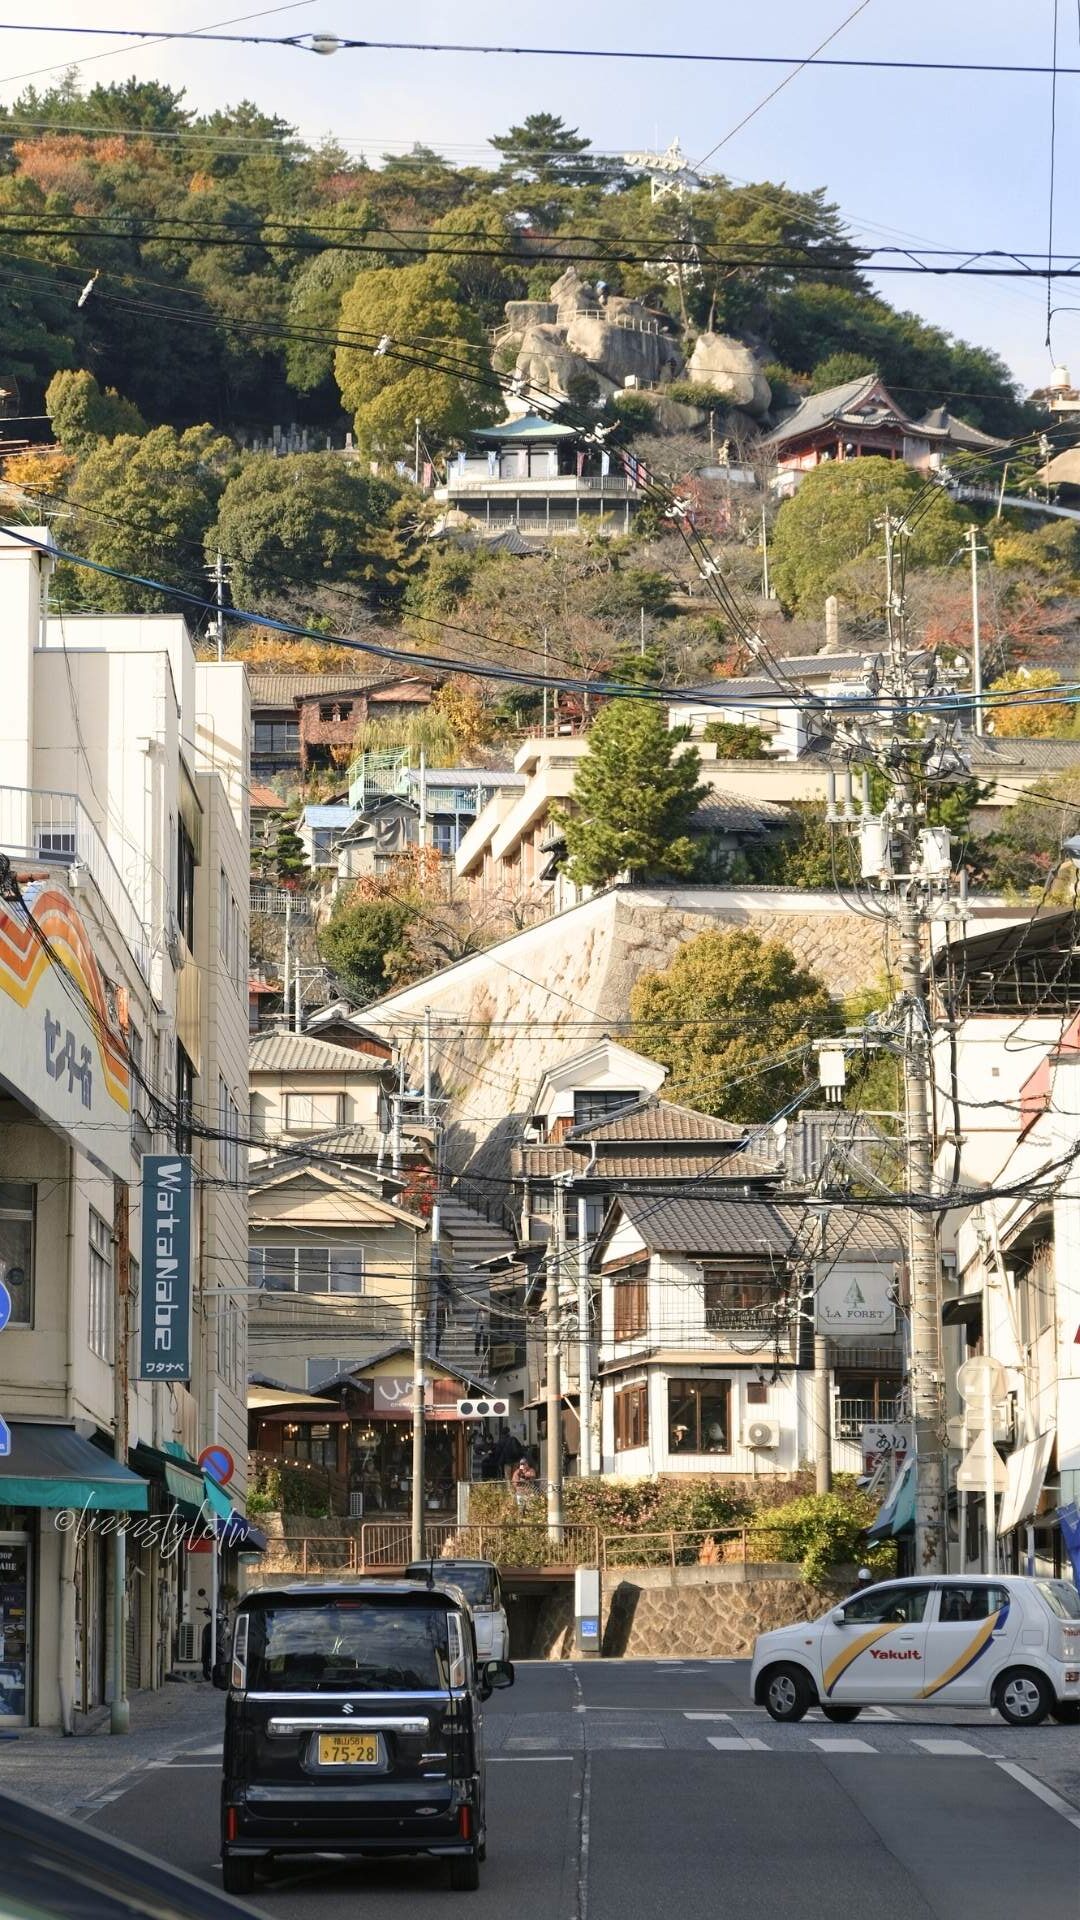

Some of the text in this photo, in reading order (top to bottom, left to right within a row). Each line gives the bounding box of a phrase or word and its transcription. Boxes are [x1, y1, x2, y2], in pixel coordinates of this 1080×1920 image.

[44, 1007, 92, 1111] センター街
[155, 1163, 182, 1351] WataNabe
[847, 1310, 884, 1318] FORET
[145, 1362, 185, 1373] ワタナベ
[869, 1649, 922, 1660] Yakult
[332, 1746, 374, 1762] 75-28
